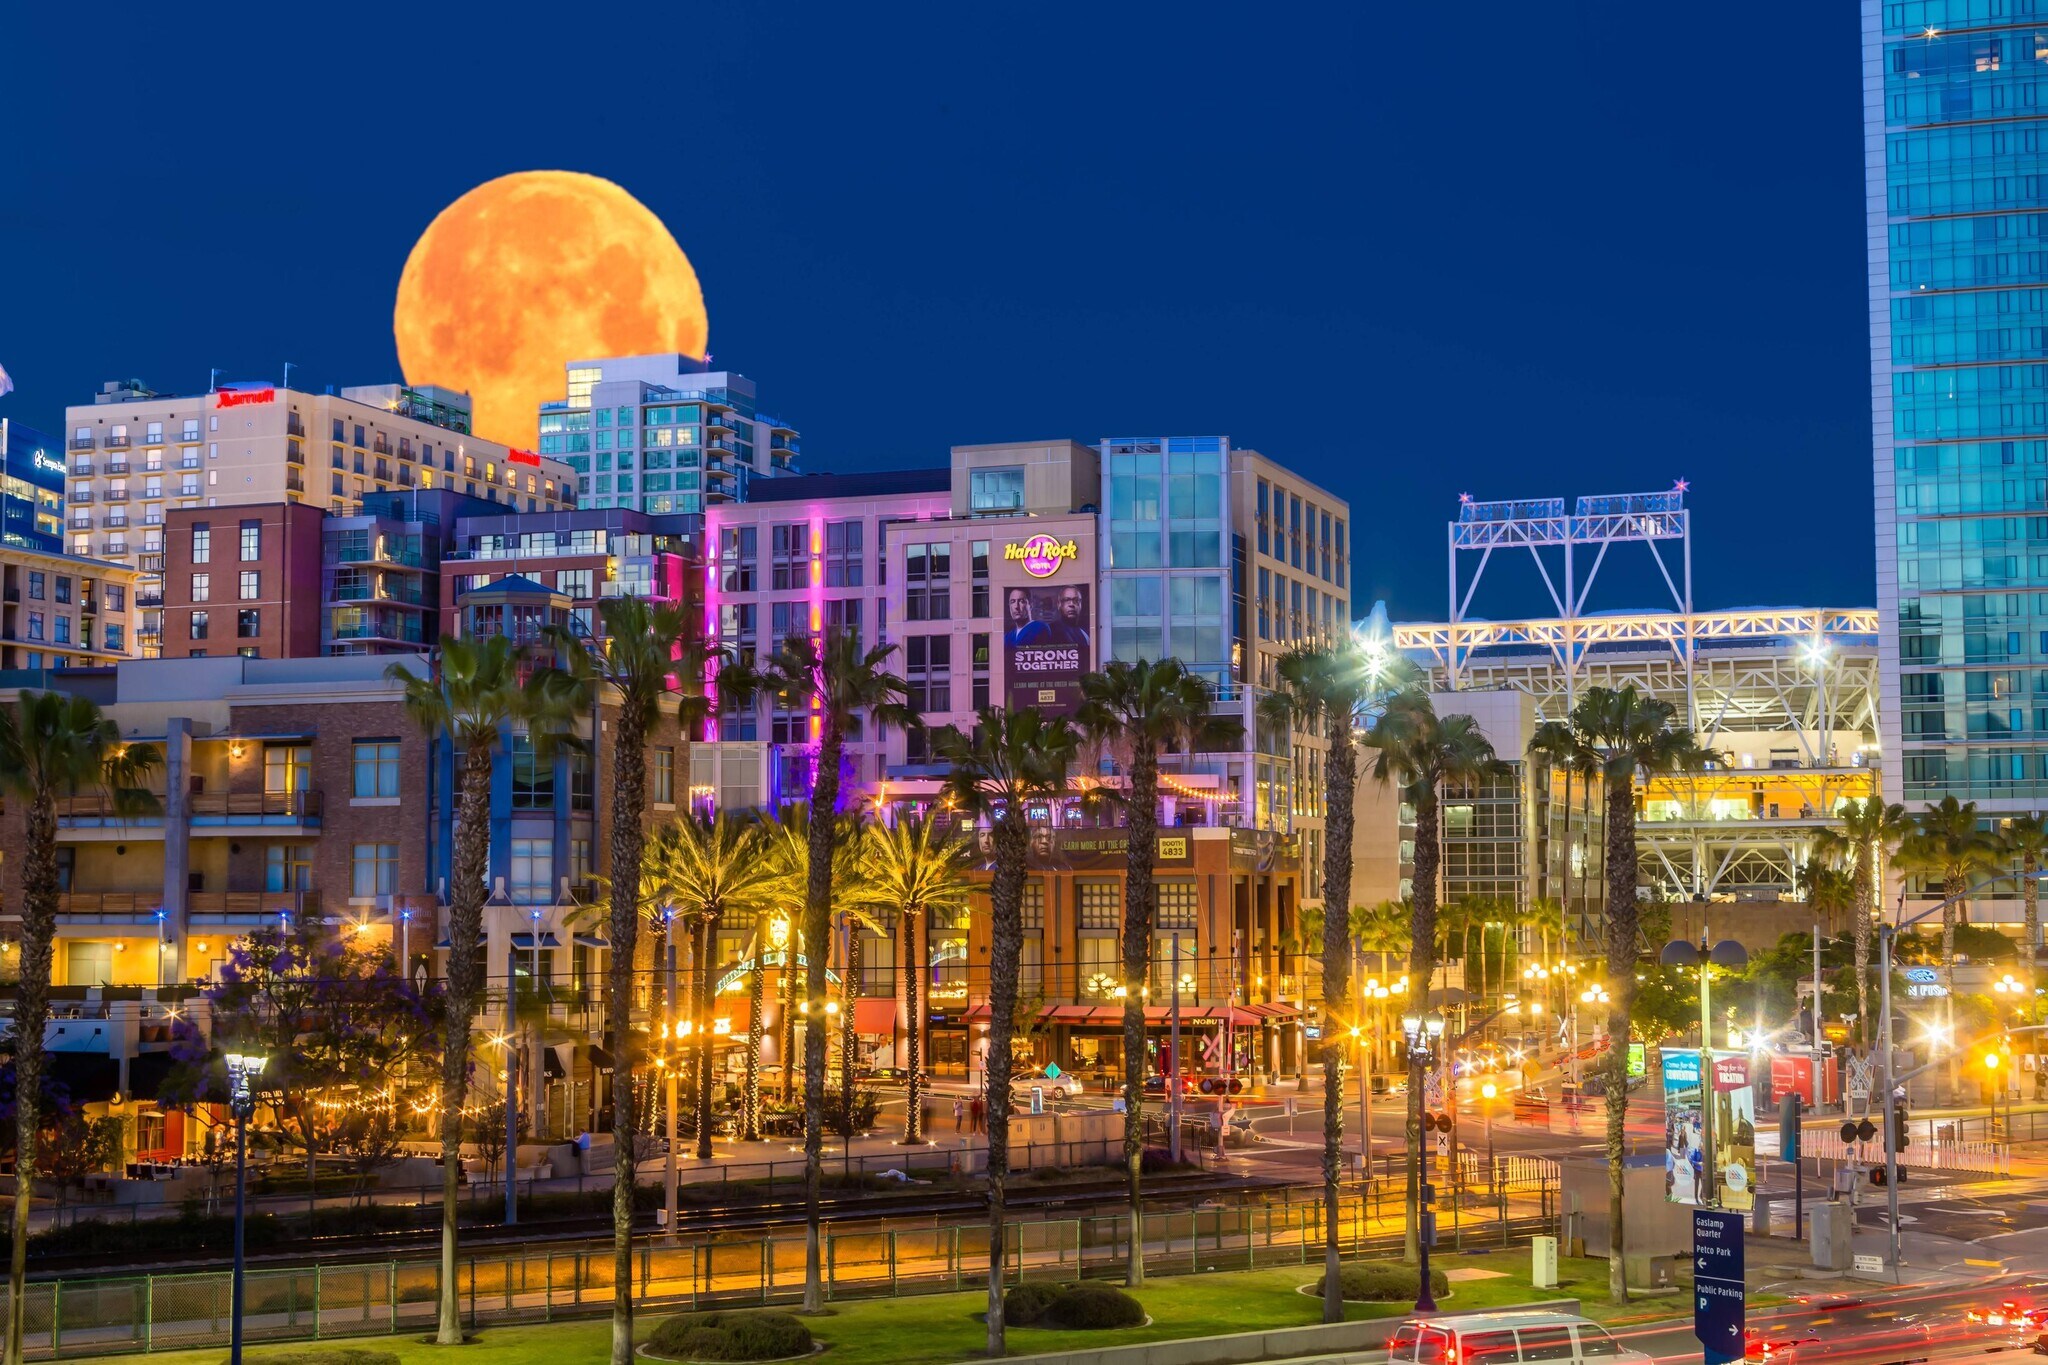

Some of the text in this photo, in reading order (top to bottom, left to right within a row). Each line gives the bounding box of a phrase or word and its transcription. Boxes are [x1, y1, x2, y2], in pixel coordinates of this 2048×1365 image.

[1004, 541, 1077, 560] Hard Rock
[1030, 562, 1052, 570] HOTEL
[1015, 650, 1079, 661] STRONG
[1015, 661, 1079, 671] TOGETHER
[1061, 840, 1080, 851] LEARN
[1080, 840, 1097, 850] MORE
[1098, 840, 1105, 850] AT
[1107, 839, 1118, 850] THE
[1161, 840, 1184, 848] BOOTH
[1162, 847, 1184, 857] 4833
[1680, 1061, 1688, 1070] for
[1688, 1061, 1698, 1070] the
[1717, 1063, 1746, 1072] Stay for the
[1666, 1069, 1698, 1081] CONVENTION
[1719, 1072, 1744, 1083] VACATION
[1696, 1218, 1724, 1229] Gaslamp
[1696, 1229, 1721, 1239] Quarter
[1697, 1245, 1731, 1257] Petco Park
[1697, 1285, 1743, 1301] Public Parking
[1700, 1298, 1707, 1309] P
